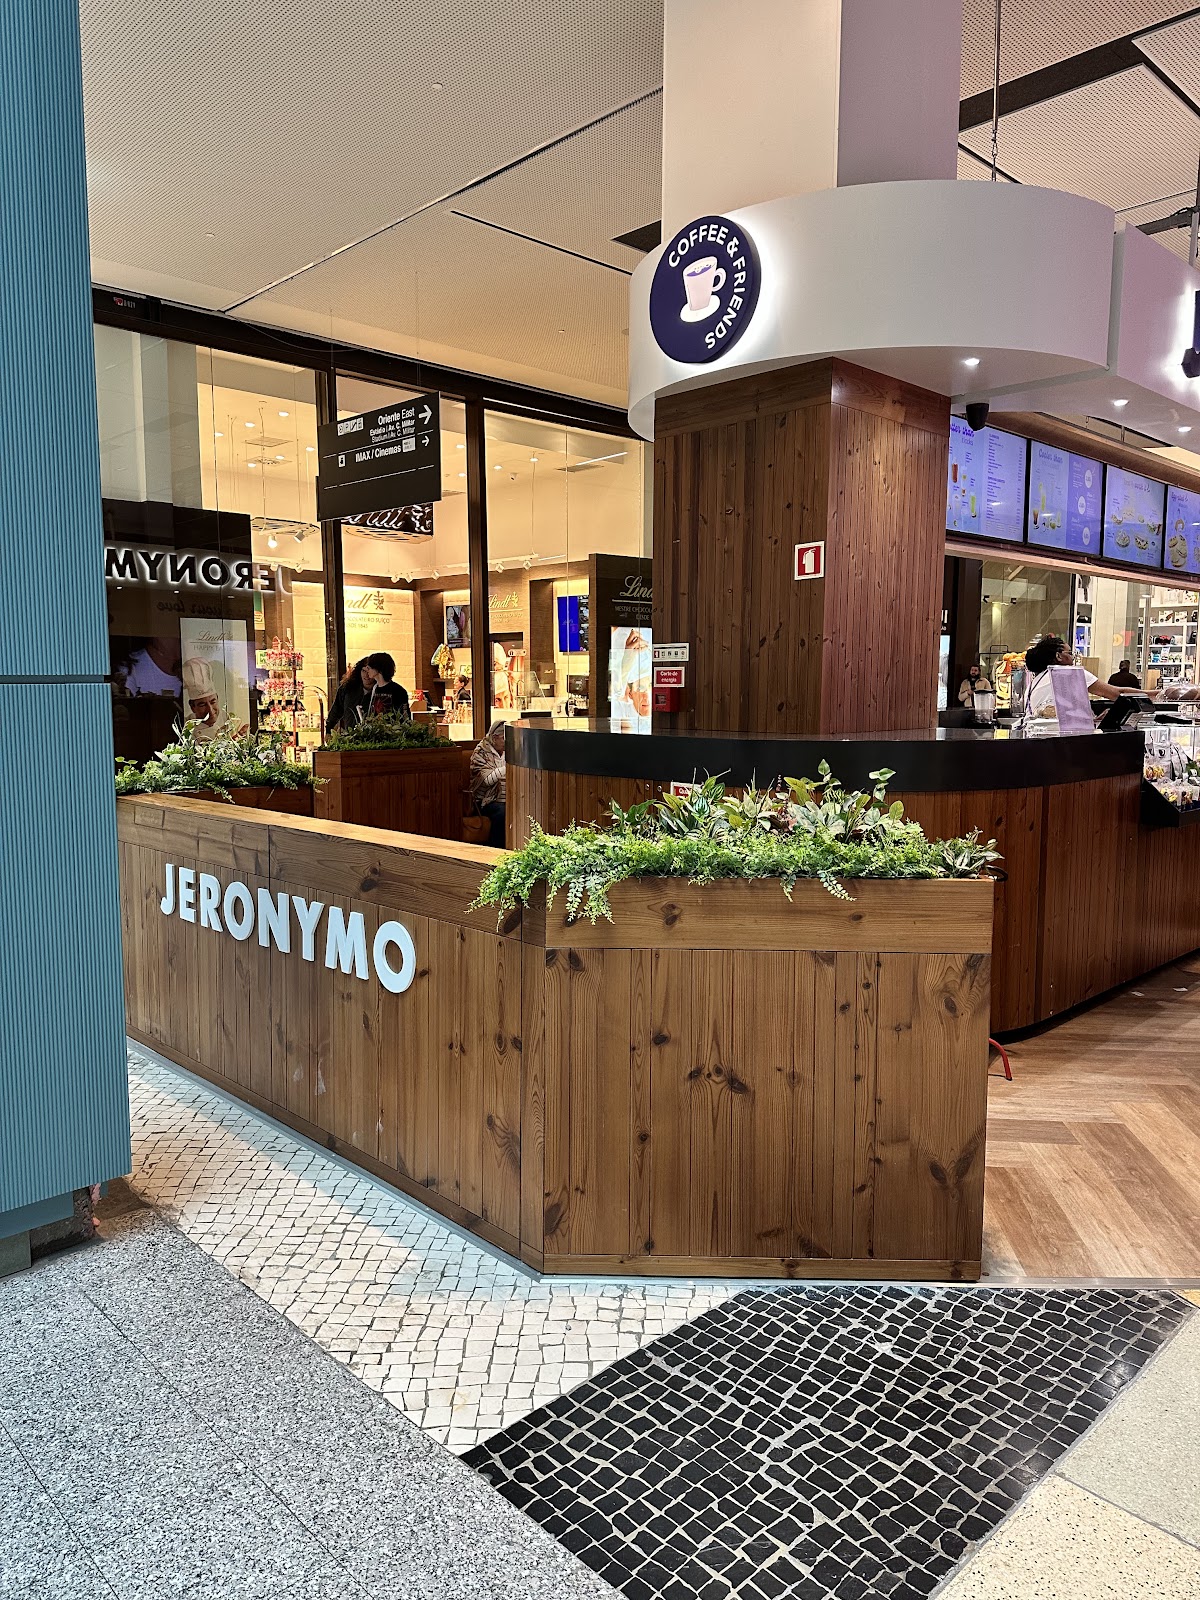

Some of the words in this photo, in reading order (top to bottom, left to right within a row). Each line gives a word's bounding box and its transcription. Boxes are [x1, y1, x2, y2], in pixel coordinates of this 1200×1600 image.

[668, 224, 729, 268] COFFEE
[726, 236, 740, 258] &
[704, 256, 747, 349] FRIENDS
[378, 412, 401, 426] Oriente
[402, 407, 415, 419] East
[355, 450, 371, 463] IMAX
[375, 445, 401, 458] Cinemas
[619, 575, 653, 599] Lin
[193, 644, 214, 652] HAPPY
[160, 863, 417, 994] JERONYMO
